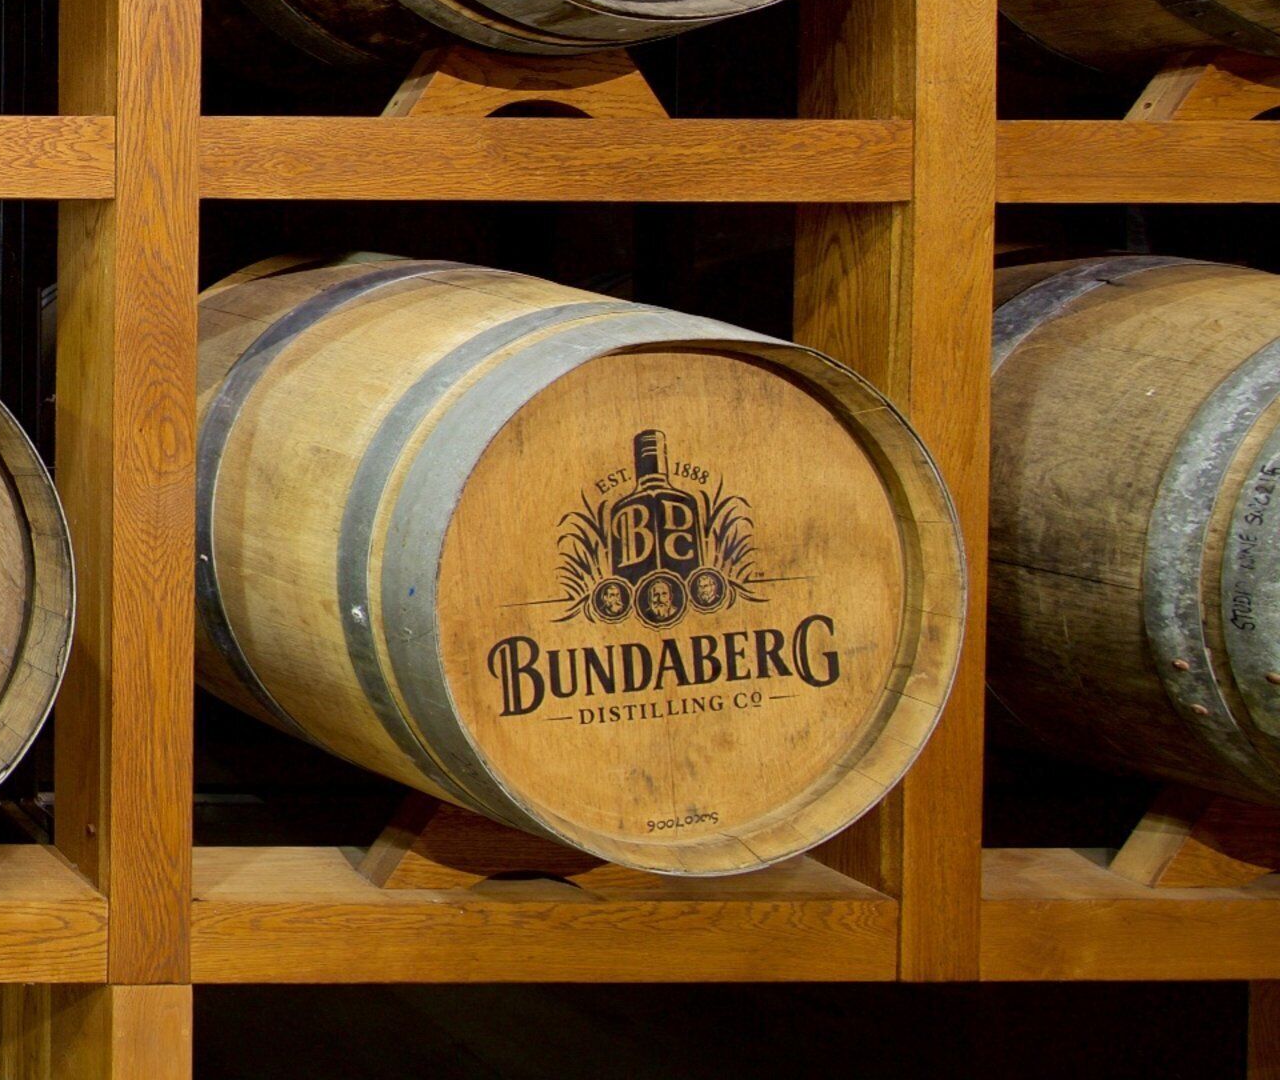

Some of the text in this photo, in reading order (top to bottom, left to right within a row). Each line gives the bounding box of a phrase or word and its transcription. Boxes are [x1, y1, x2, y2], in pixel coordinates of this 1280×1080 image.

[594, 461, 710, 494] EST. 1888
[487, 614, 841, 717] BUNDABERG
[579, 696, 724, 725] DISTILLING
